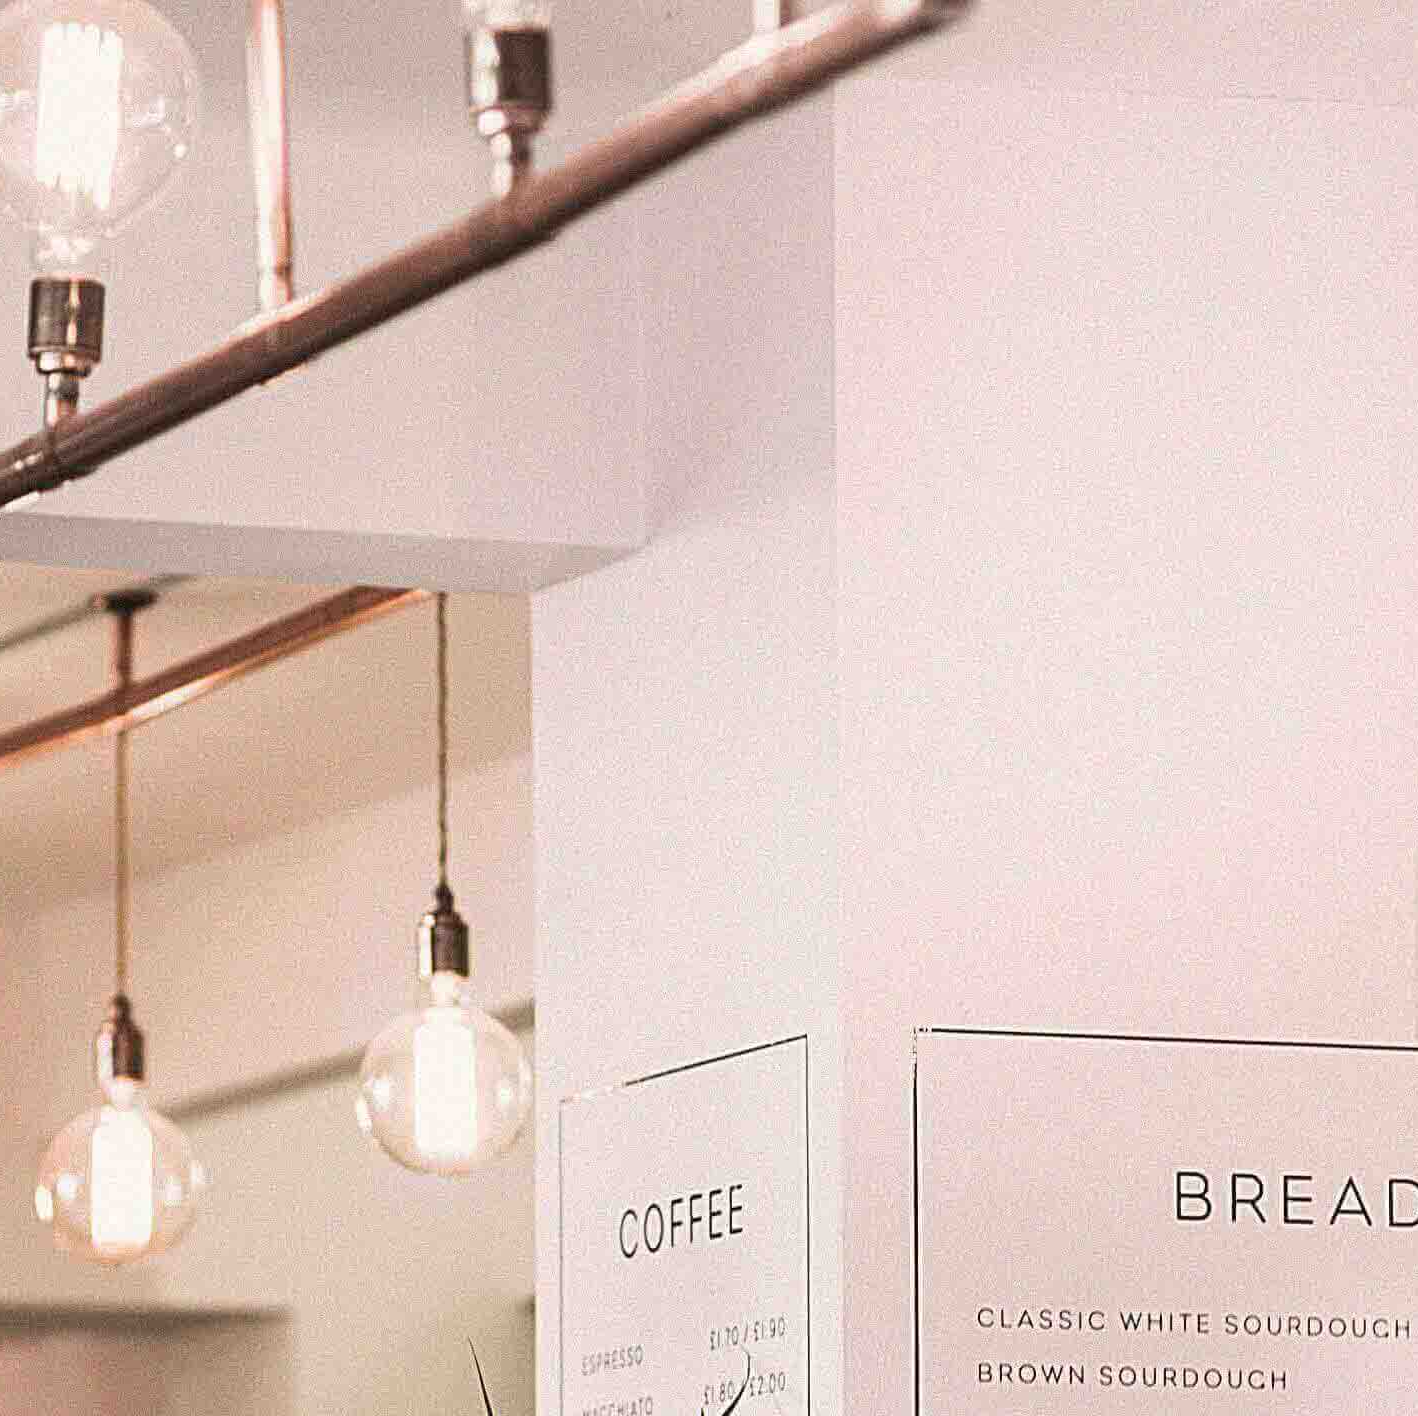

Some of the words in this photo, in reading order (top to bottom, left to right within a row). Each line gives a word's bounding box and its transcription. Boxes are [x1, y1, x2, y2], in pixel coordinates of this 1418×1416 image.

[620, 1184, 744, 1258] COFFEE
[976, 1306, 1106, 1332] CLASSIC
[1118, 1311, 1210, 1335] WHITE
[1224, 1313, 1411, 1340] SOURDOUGH
[977, 1362, 1086, 1386] BROWN
[1099, 1364, 1287, 1391] SOURDOUGH
